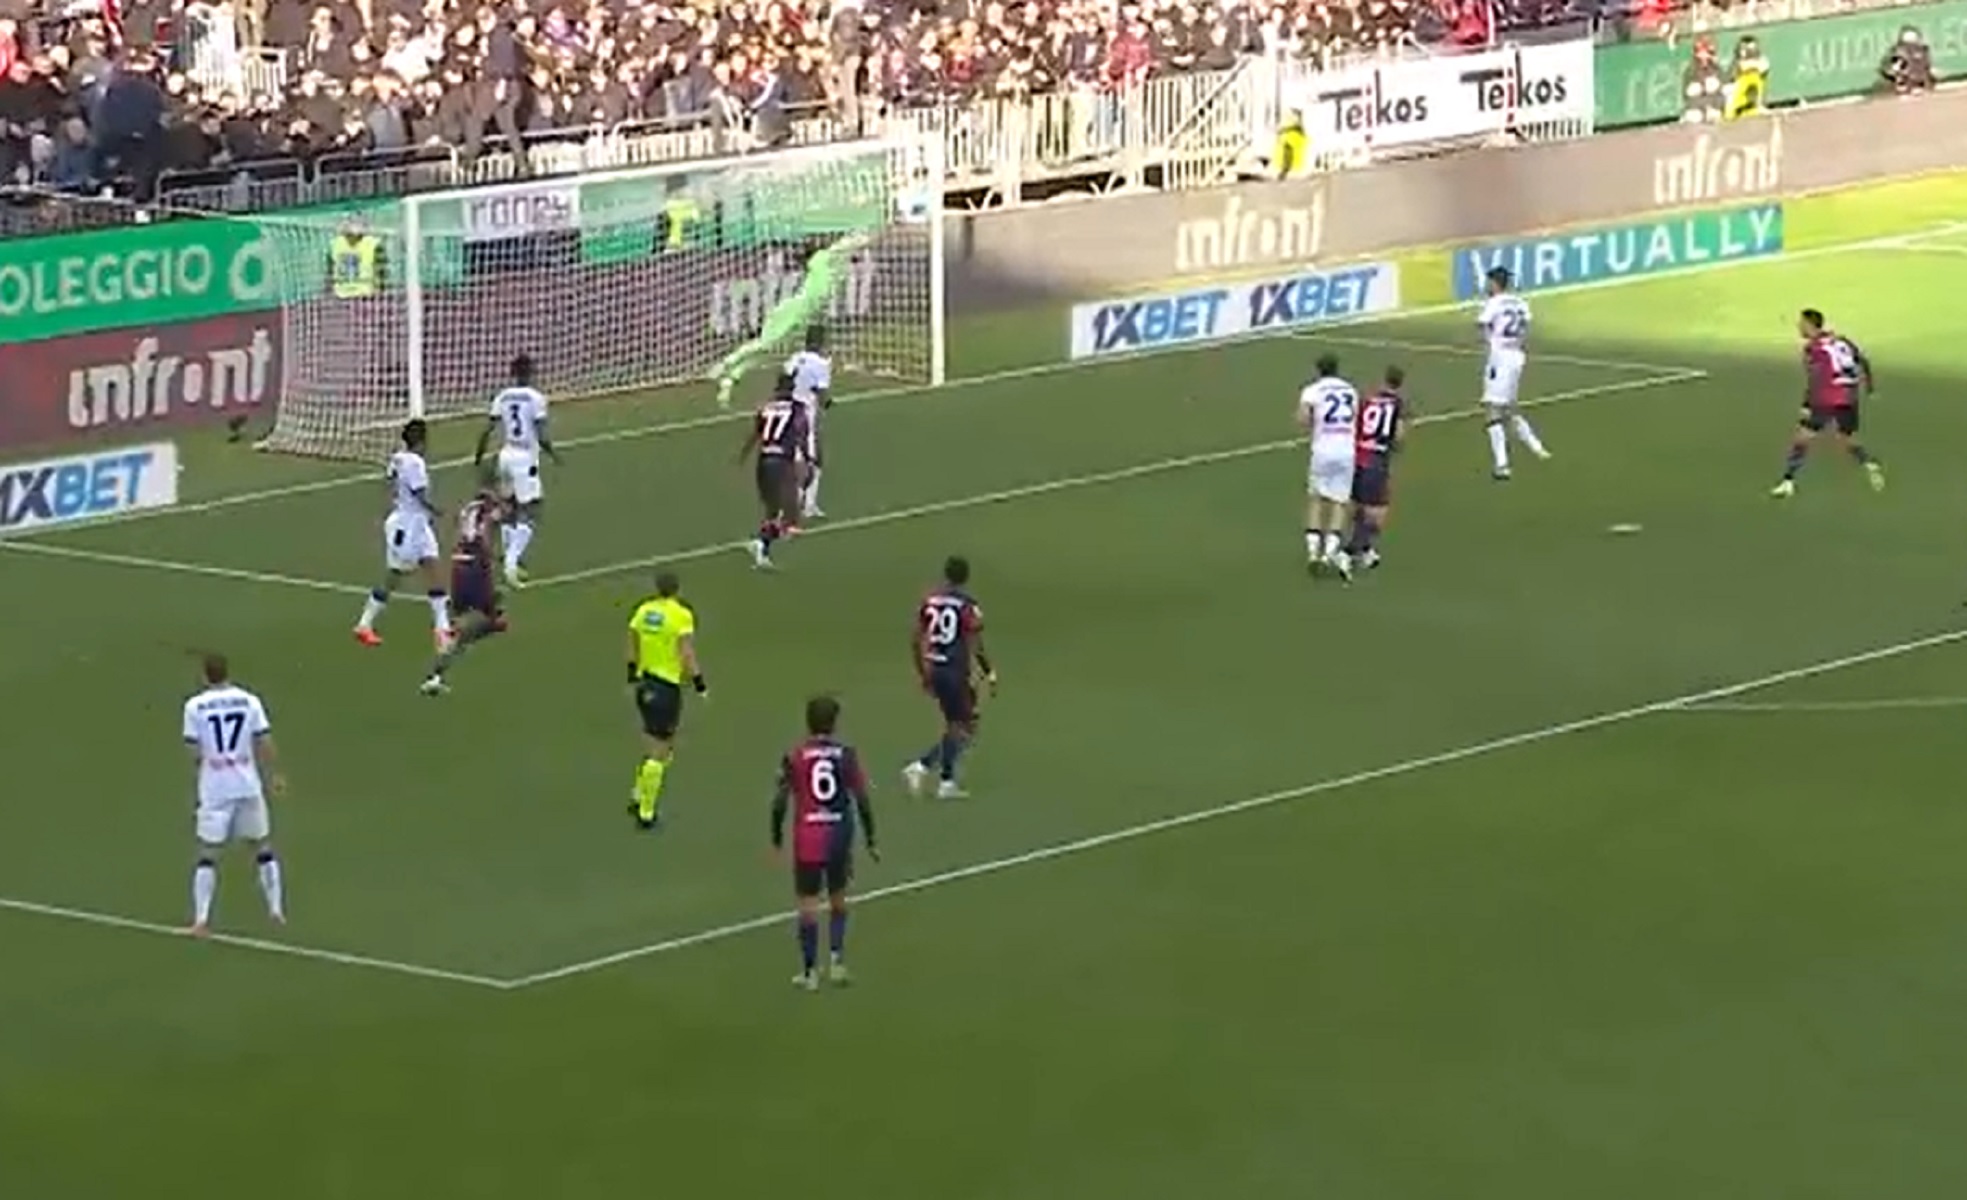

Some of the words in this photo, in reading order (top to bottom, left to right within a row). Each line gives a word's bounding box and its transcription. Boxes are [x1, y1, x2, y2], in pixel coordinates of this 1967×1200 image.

[1318, 69, 1428, 133] Teikos
[1460, 51, 1567, 112] Teikos
[1174, 190, 1324, 270] infront
[1470, 207, 1775, 291] VIRTUALLY
[0, 245, 211, 315] OLEGGIO
[1092, 290, 1228, 350] 1XBET
[1249, 267, 1379, 327] 1XBET
[69, 329, 272, 428] infront
[761, 409, 792, 441] 77
[1323, 392, 1354, 423] 23
[1363, 404, 1396, 436] 91
[925, 605, 958, 645] 29
[207, 711, 246, 753] 17
[811, 758, 837, 801] 6
